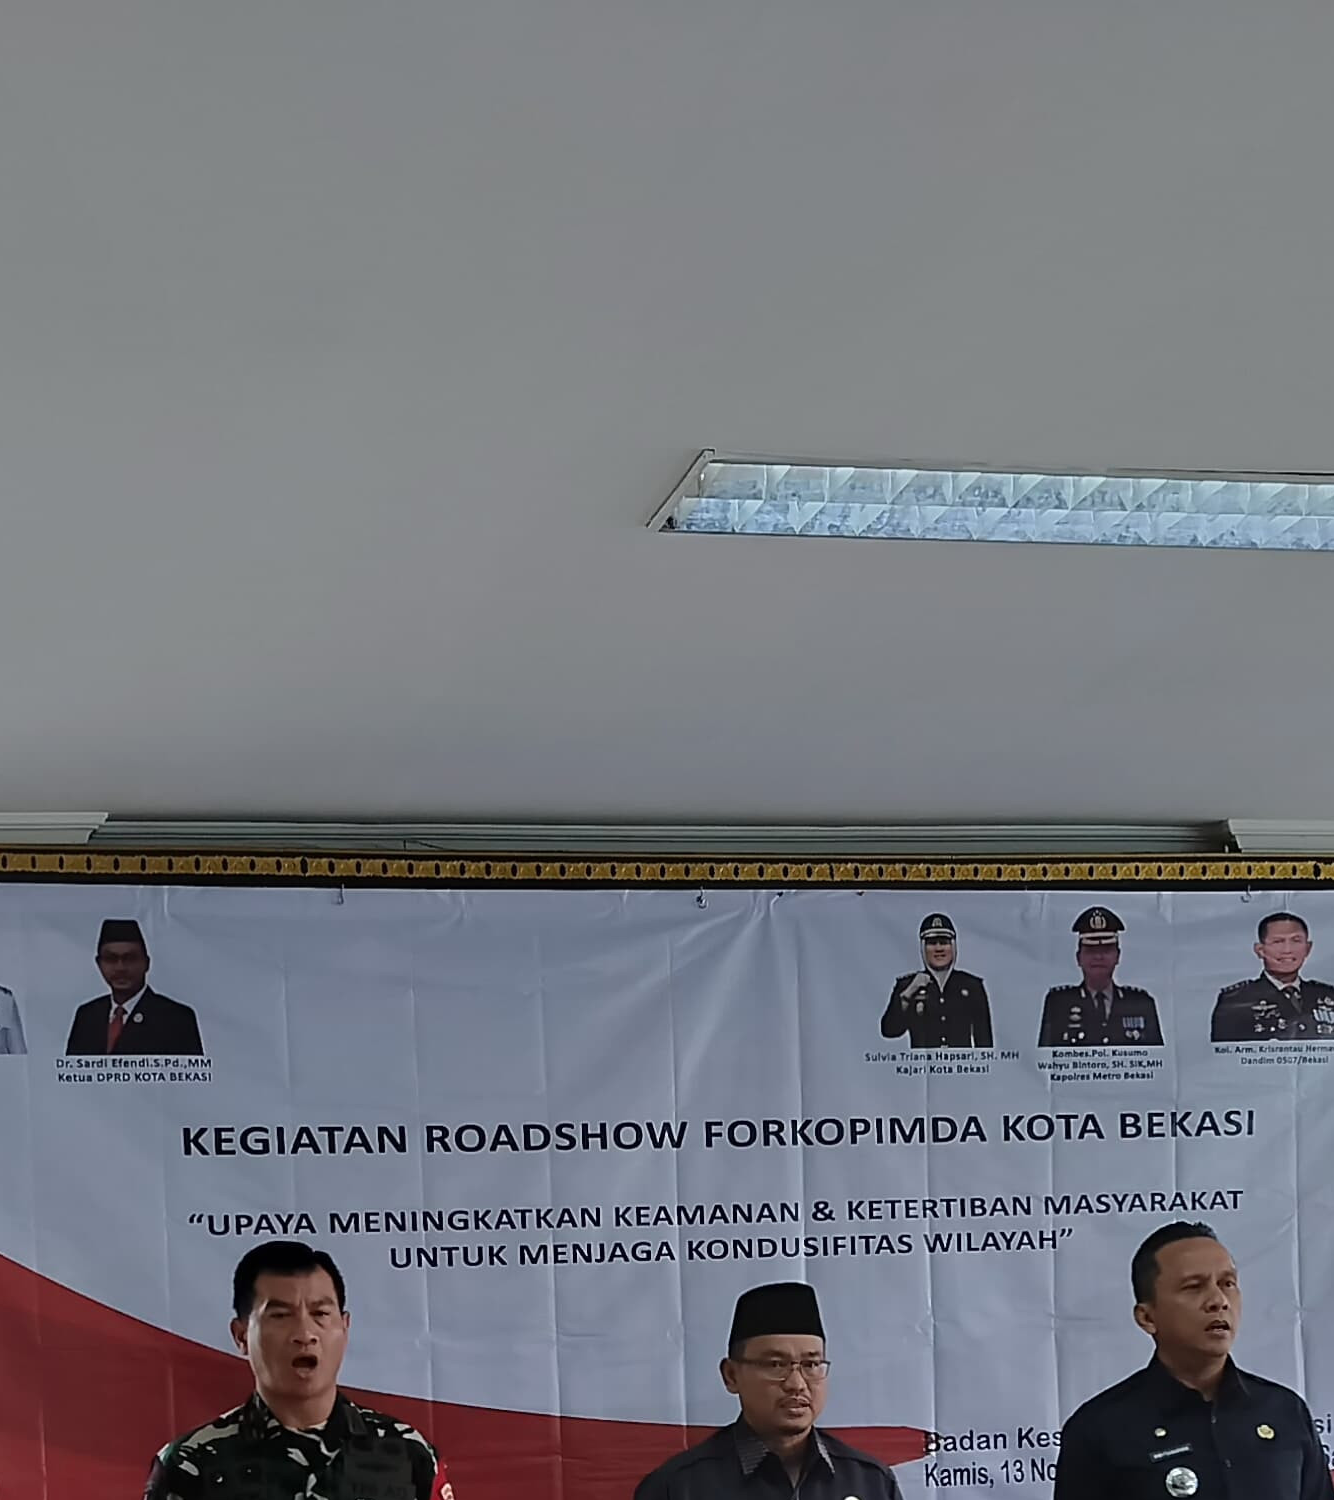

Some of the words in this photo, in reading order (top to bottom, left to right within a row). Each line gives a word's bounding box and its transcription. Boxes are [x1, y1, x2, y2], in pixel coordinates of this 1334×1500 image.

[900, 1052, 932, 1062] Triana
[1000, 1051, 1020, 1061] MH
[56, 1058, 73, 1069] Dr.
[76, 1058, 107, 1069] Sardi
[1037, 1061, 1070, 1071] Wahyu
[896, 1064, 927, 1076] Kajari
[929, 1064, 953, 1075] Kota
[956, 1064, 989, 1074] Bekasi
[1050, 1072, 1091, 1082] Kapolres
[1092, 1071, 1122, 1081] Metro
[1123, 1070, 1154, 1080] Bekasi
[58, 1072, 93, 1083] Ketua
[97, 1072, 131, 1083] DPRD
[135, 1072, 166, 1083] KOTA
[169, 1072, 212, 1083] BEKASI
[182, 1124, 408, 1156] KEGIATAN
[425, 1120, 689, 1154] ROADSHOW
[704, 1115, 988, 1149] FORKOPIMDA
[1002, 1112, 1105, 1143] KOTA
[1118, 1109, 1256, 1140] BEKASI
[188, 1212, 318, 1237] “UPAYA
[329, 1206, 603, 1235] MENINGKATKAN
[613, 1202, 801, 1228] KEAMANAN
[811, 1200, 836, 1222] &
[846, 1196, 1033, 1222] KETERTIBAN
[1043, 1190, 1245, 1217] MASYARAKAT
[389, 1245, 509, 1270] UNTUK
[518, 1240, 677, 1267] MENJAGA
[686, 1232, 915, 1262] KONDUSIFITAS
[923, 1227, 1075, 1255] WILAYAH”
[925, 1429, 1007, 1452] Badan
[924, 1461, 994, 1489] Kamis,
[1000, 1458, 1025, 1484] 13
